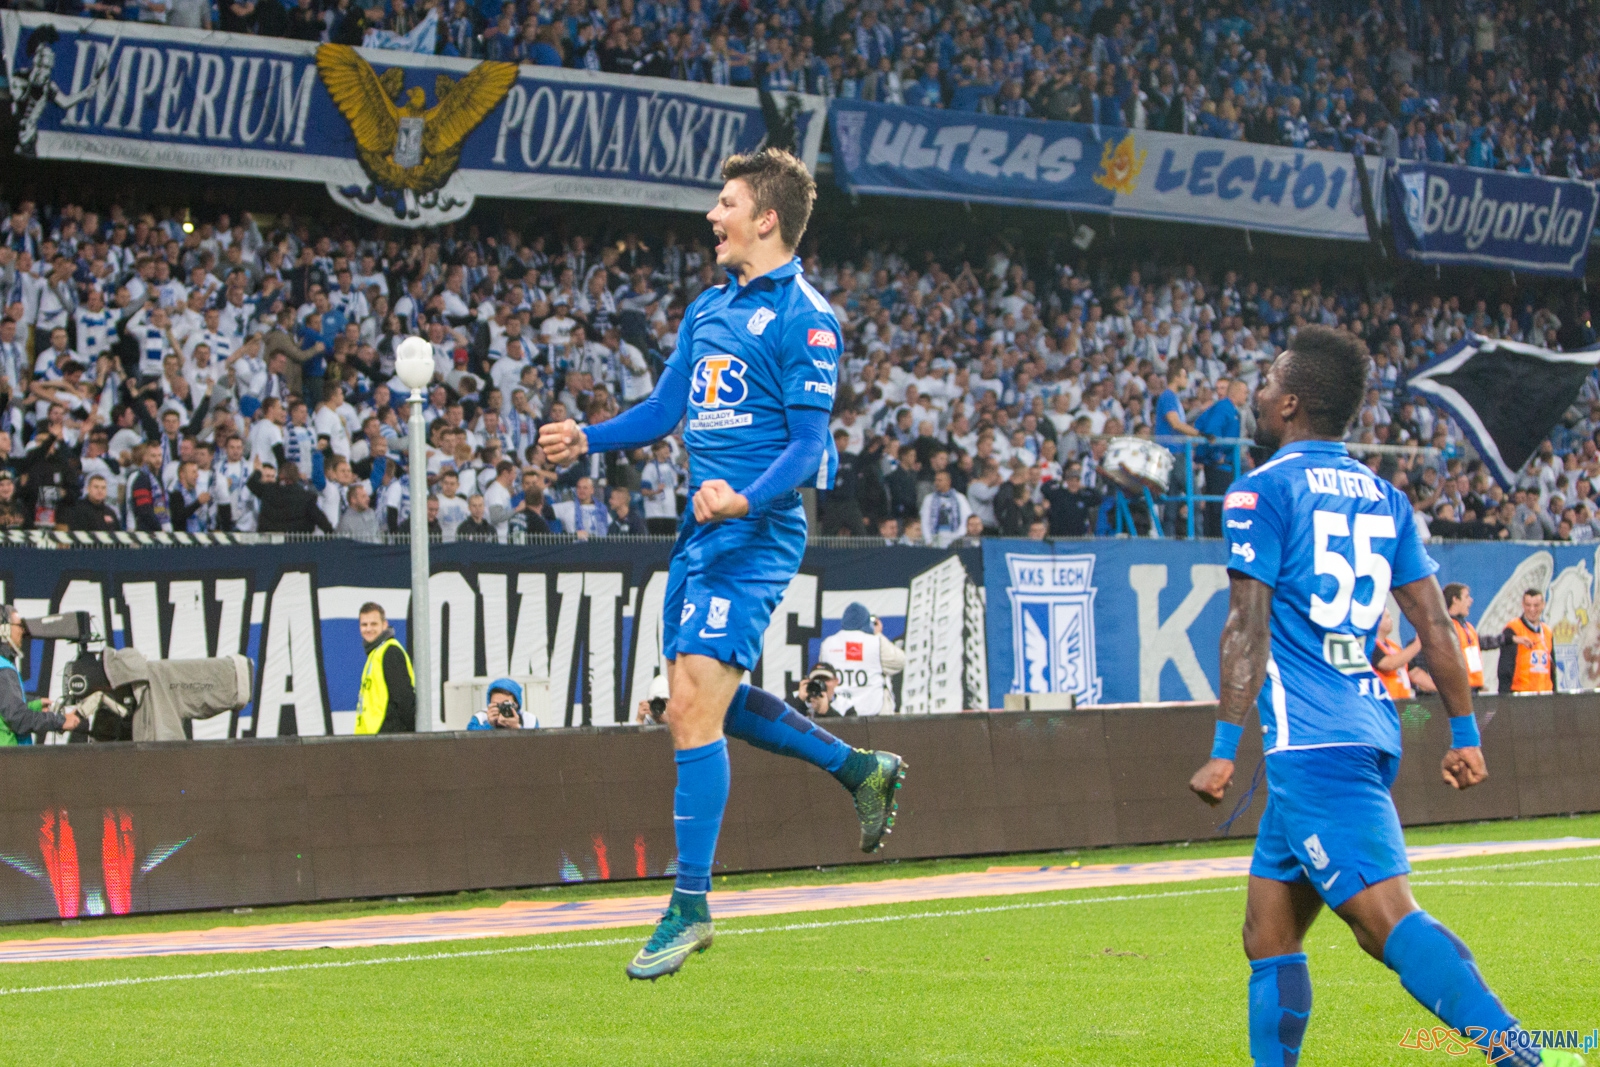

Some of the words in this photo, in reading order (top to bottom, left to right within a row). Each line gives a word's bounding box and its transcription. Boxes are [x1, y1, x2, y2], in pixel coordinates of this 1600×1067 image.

[61, 38, 320, 149] IMPERIUM
[492, 82, 748, 184] POZNAŃSKIE
[865, 119, 1083, 183] ULTRAS
[689, 354, 748, 408] STS
[1019, 567, 1044, 586] KKS
[1052, 567, 1085, 586] LECH
[1309, 510, 1397, 631] 55
